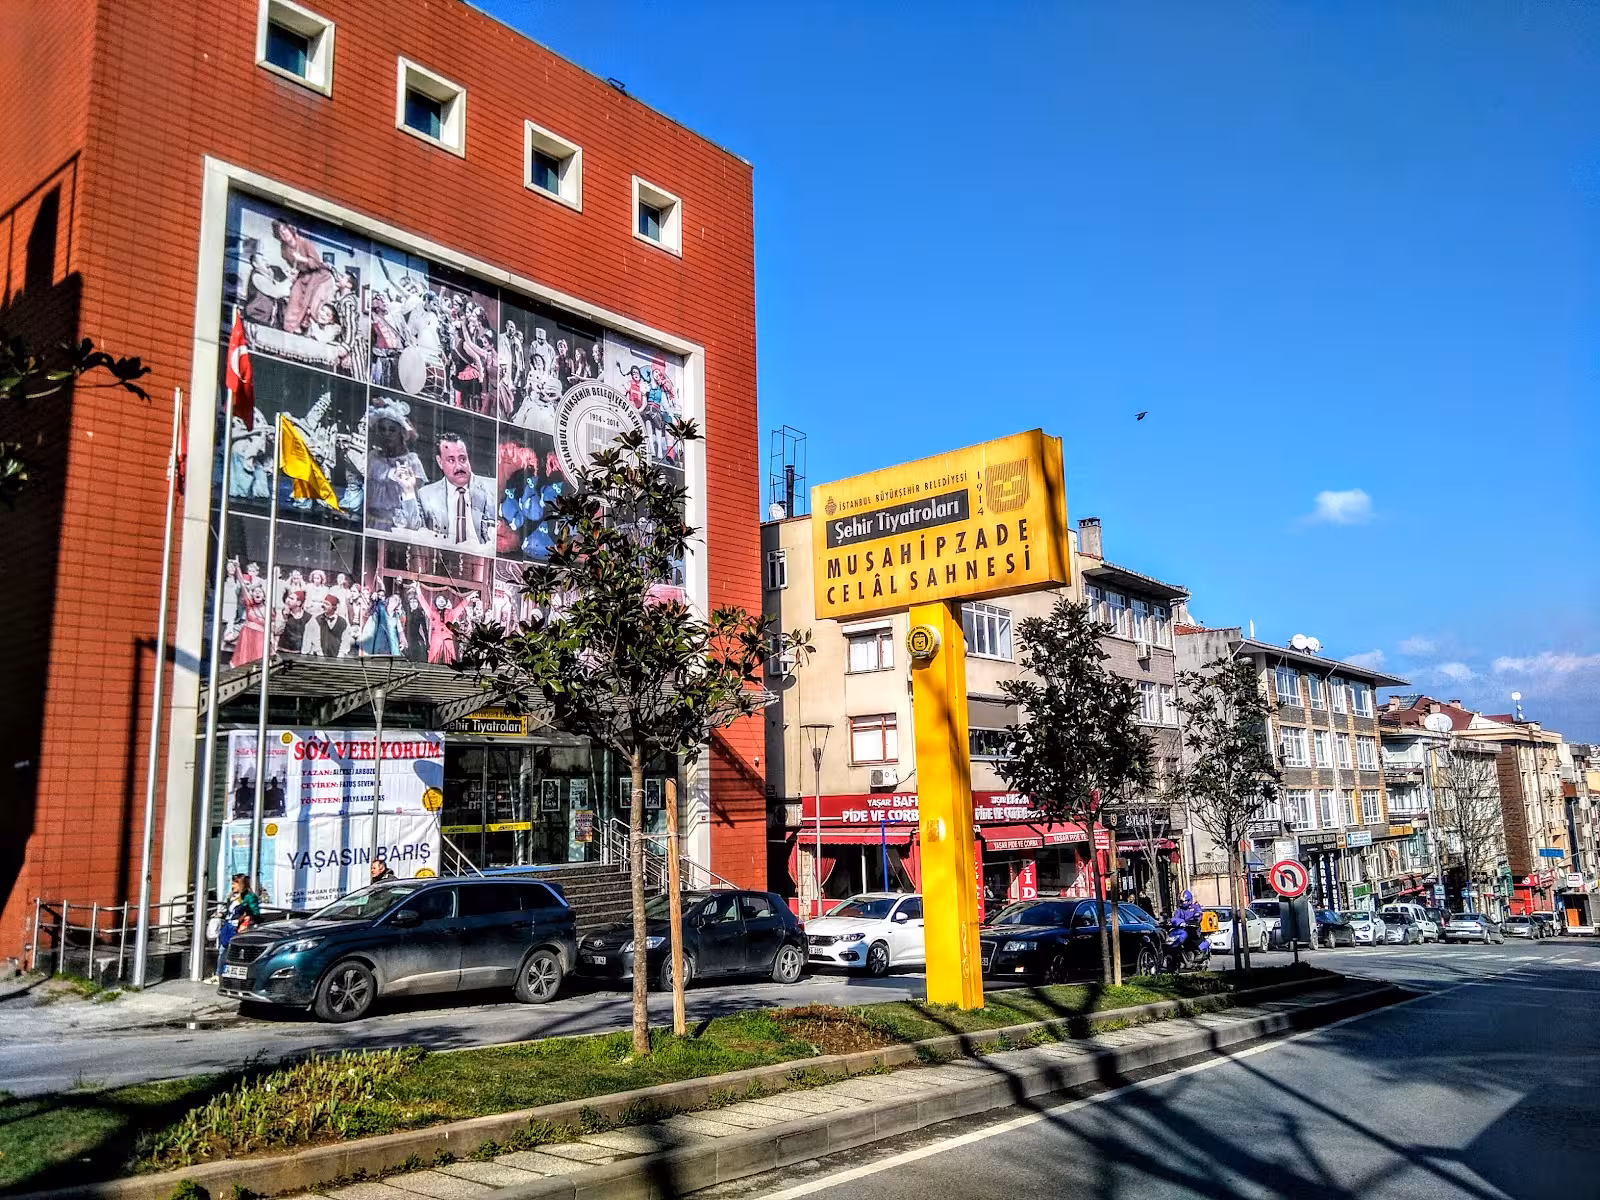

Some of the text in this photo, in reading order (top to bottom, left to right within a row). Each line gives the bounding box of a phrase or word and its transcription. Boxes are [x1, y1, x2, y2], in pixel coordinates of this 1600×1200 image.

[559, 386, 592, 427] BÜYÜKŞEHİR
[591, 386, 630, 413] BELEDİYESİ
[589, 412, 602, 423] 1914
[606, 417, 620, 429] 2014
[839, 470, 968, 511] İSTANBUL BÜYÜKŞEHİR BELEDİYESİ
[834, 498, 960, 544] Şehir Tiyatroları
[827, 518, 1028, 579] MUSAHİPZADE
[827, 544, 1031, 605] CELÂL SAHNESİ
[472, 719, 522, 734] Tiyatroları
[294, 735, 441, 761] SÖZ VERİYORUM
[301, 781, 339, 790] ÇEVİREN:
[361, 794, 385, 802] KARAAŞ
[842, 808, 919, 824] PİDE VE ÇORB
[867, 799, 892, 808] YAŞAR
[287, 842, 431, 873] YAŞASIN BARIŞ
[1021, 858, 1037, 898] PİD
